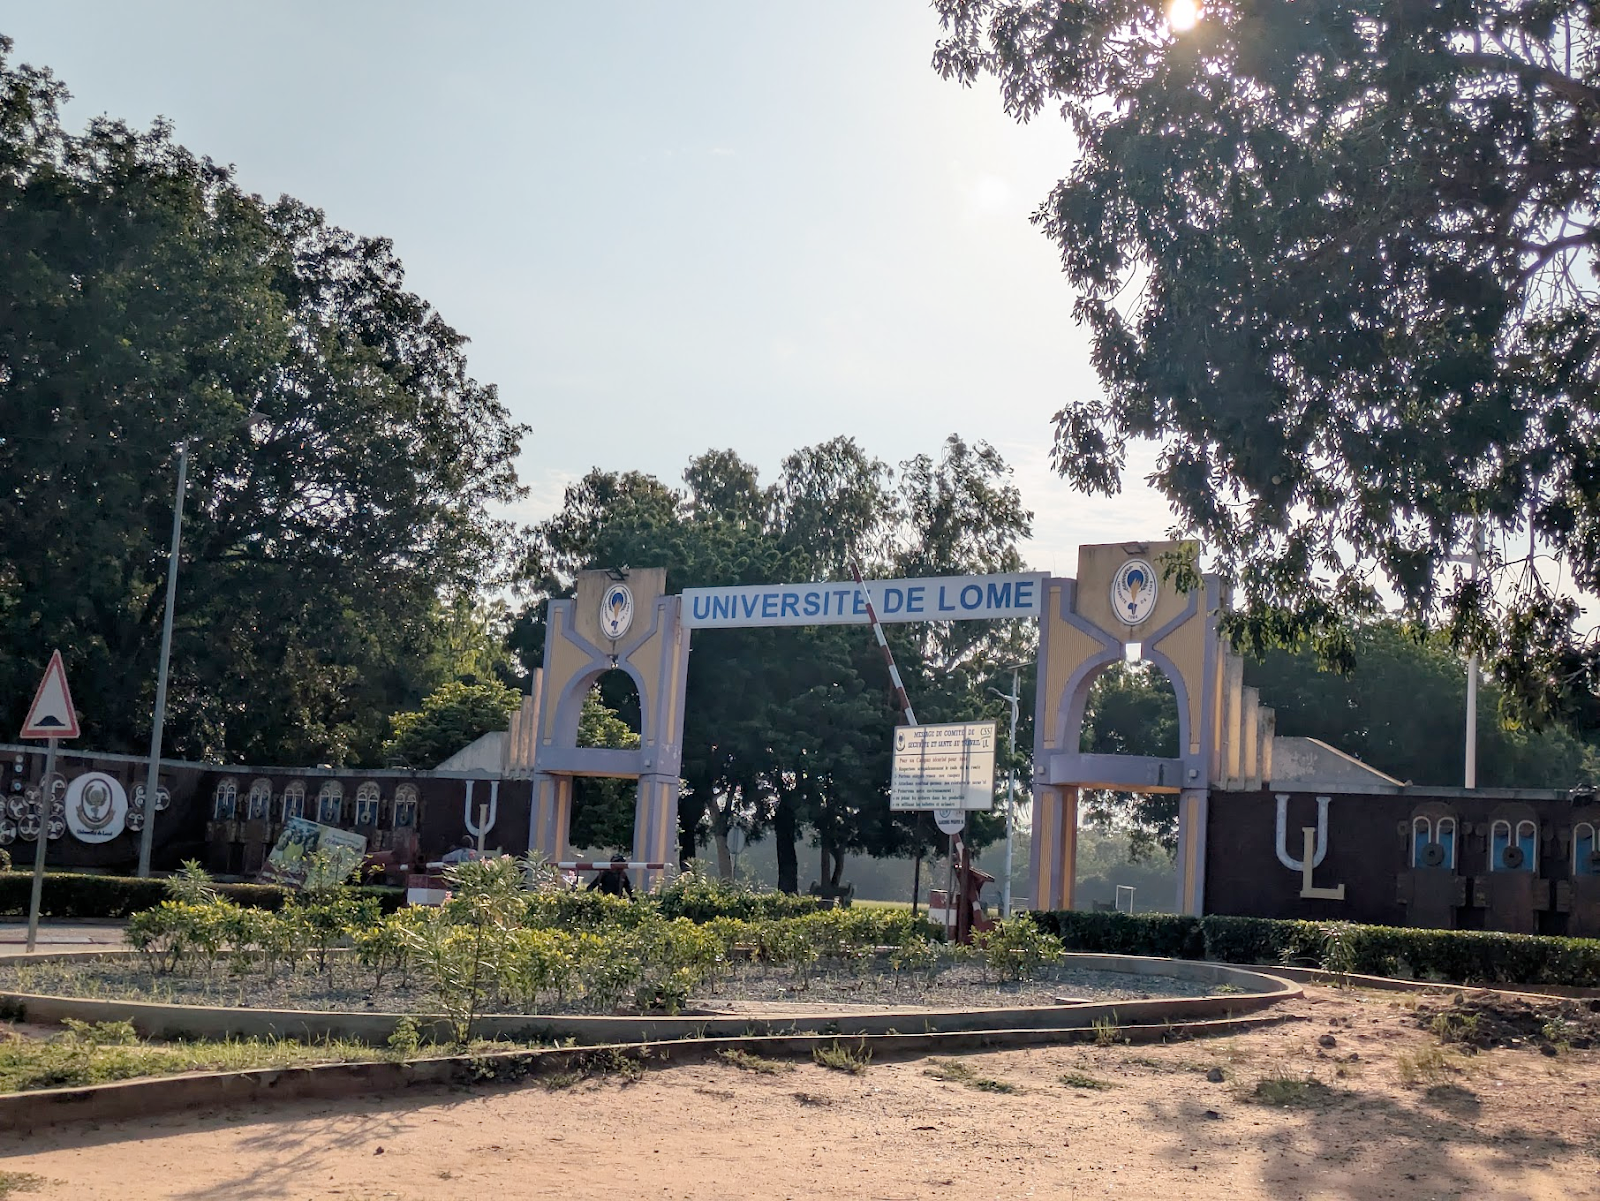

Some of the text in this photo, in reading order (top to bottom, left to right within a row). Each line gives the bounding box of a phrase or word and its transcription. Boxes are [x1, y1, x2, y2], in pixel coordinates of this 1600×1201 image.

[693, 581, 1034, 620] UNIVERSITE DE LOME
